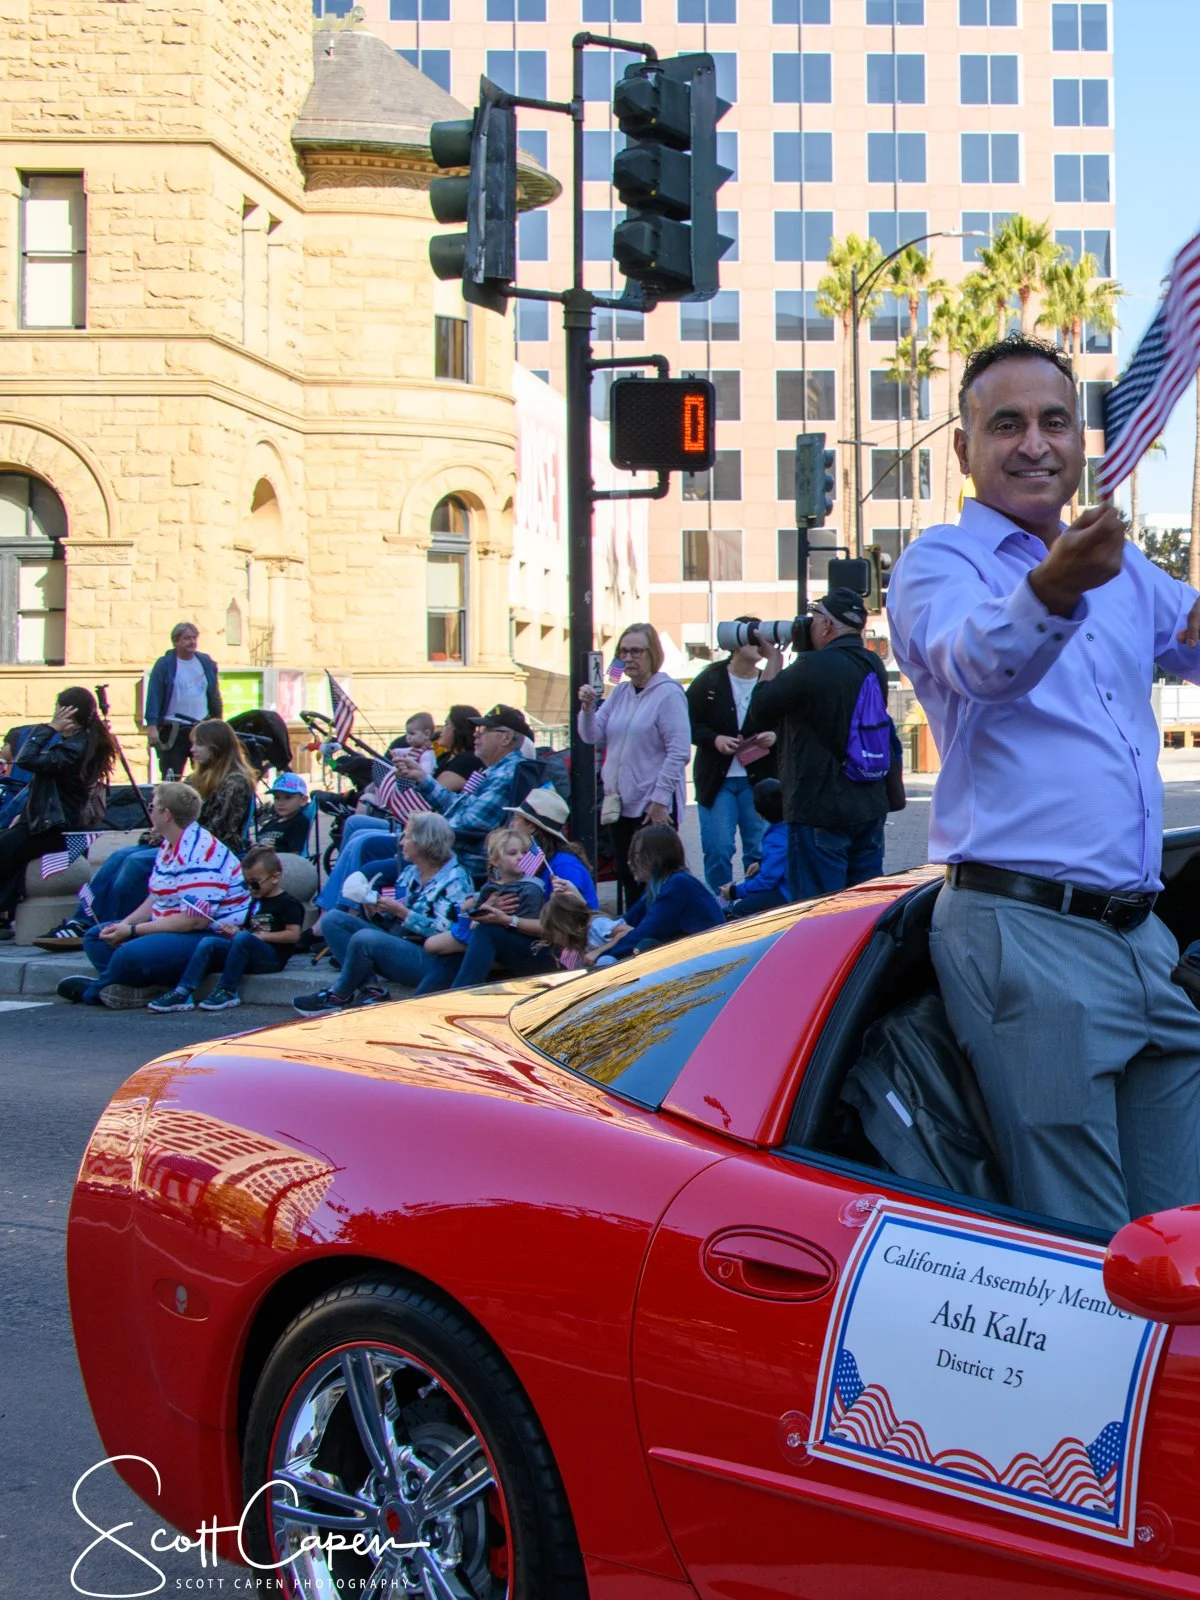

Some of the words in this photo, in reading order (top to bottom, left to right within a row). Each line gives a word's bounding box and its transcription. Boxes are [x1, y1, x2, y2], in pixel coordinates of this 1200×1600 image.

[684, 394, 705, 452] 0
[883, 1244, 967, 1281] California
[969, 1265, 1056, 1306] Assembly
[930, 1299, 978, 1334] Ash
[982, 1310, 1048, 1352] Kalra
[936, 1348, 995, 1381] District
[1002, 1366, 1024, 1389] 25
